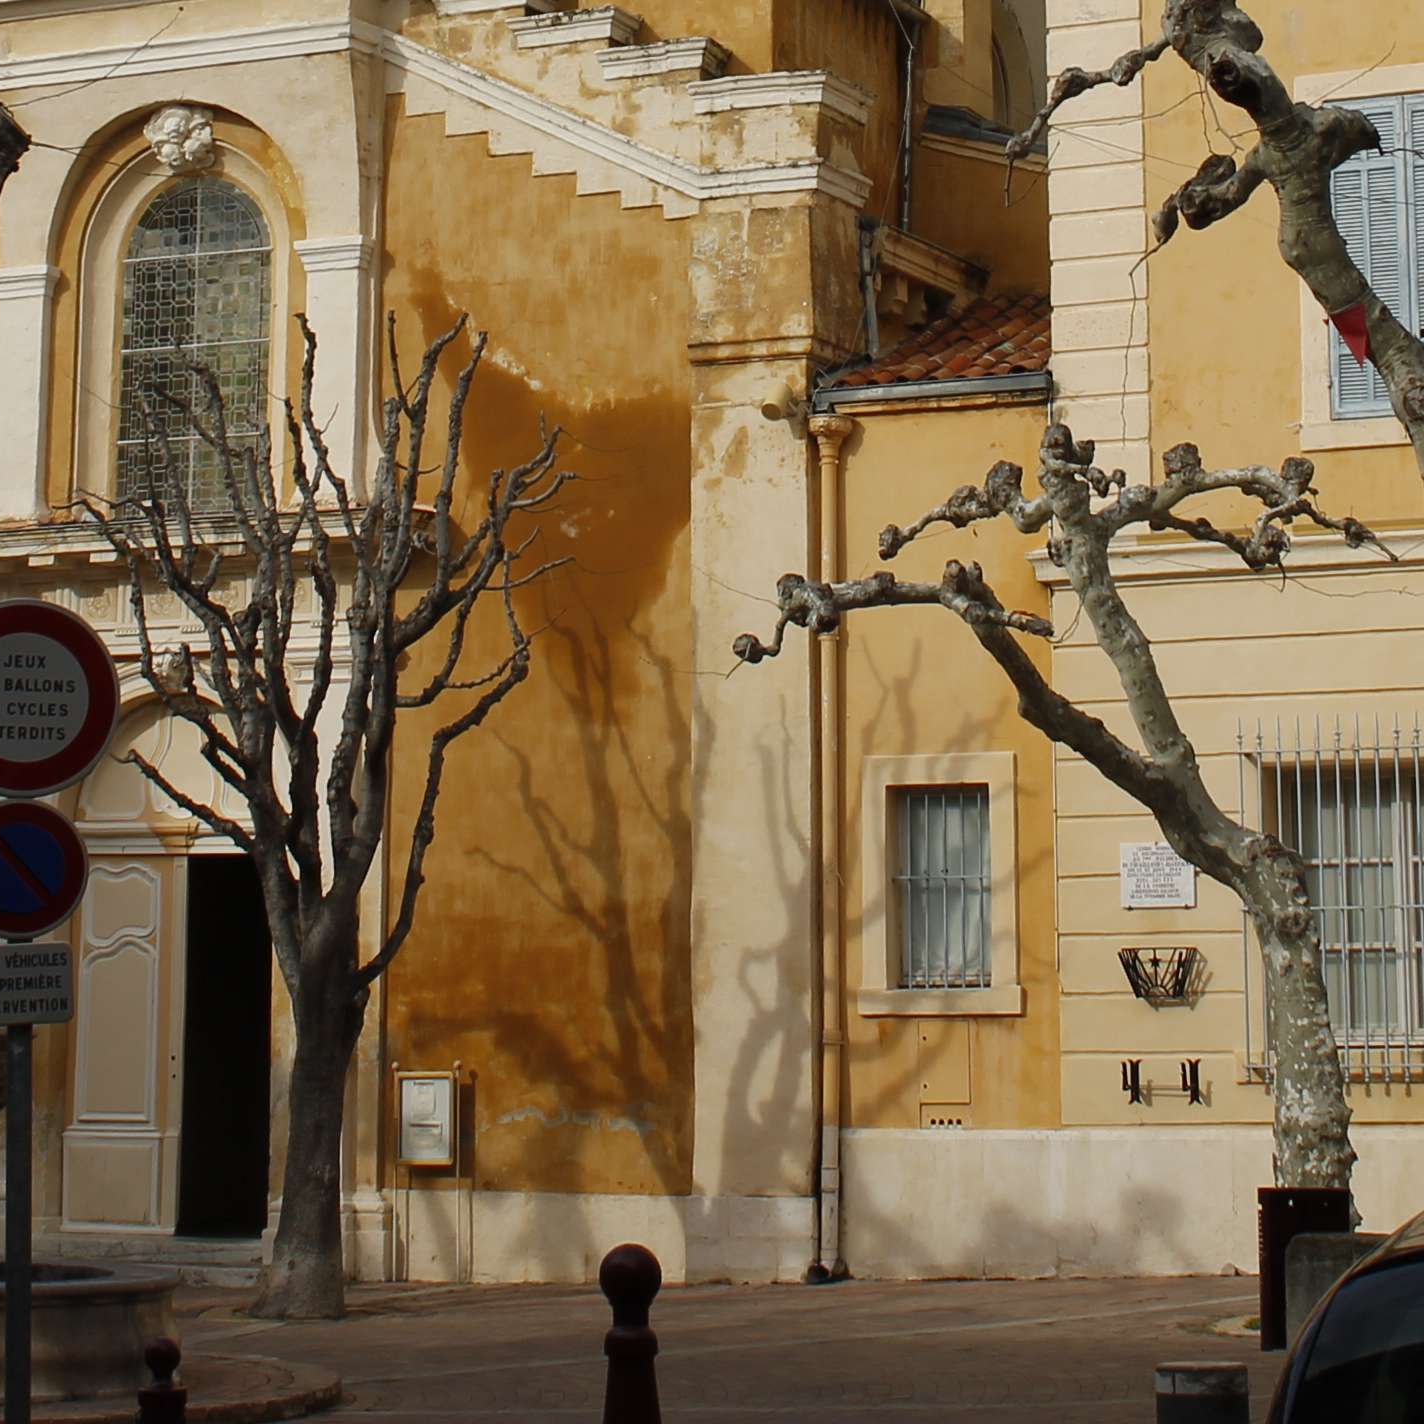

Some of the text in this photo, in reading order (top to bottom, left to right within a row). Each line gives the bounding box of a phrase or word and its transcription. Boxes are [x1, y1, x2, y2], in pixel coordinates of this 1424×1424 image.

[3, 654, 47, 669] JEUX
[3, 678, 76, 693] BALLONS
[7, 702, 69, 716] CYCLES
[5, 952, 67, 968] VÉHICULES
[0, 974, 63, 992] PREMIÈRE
